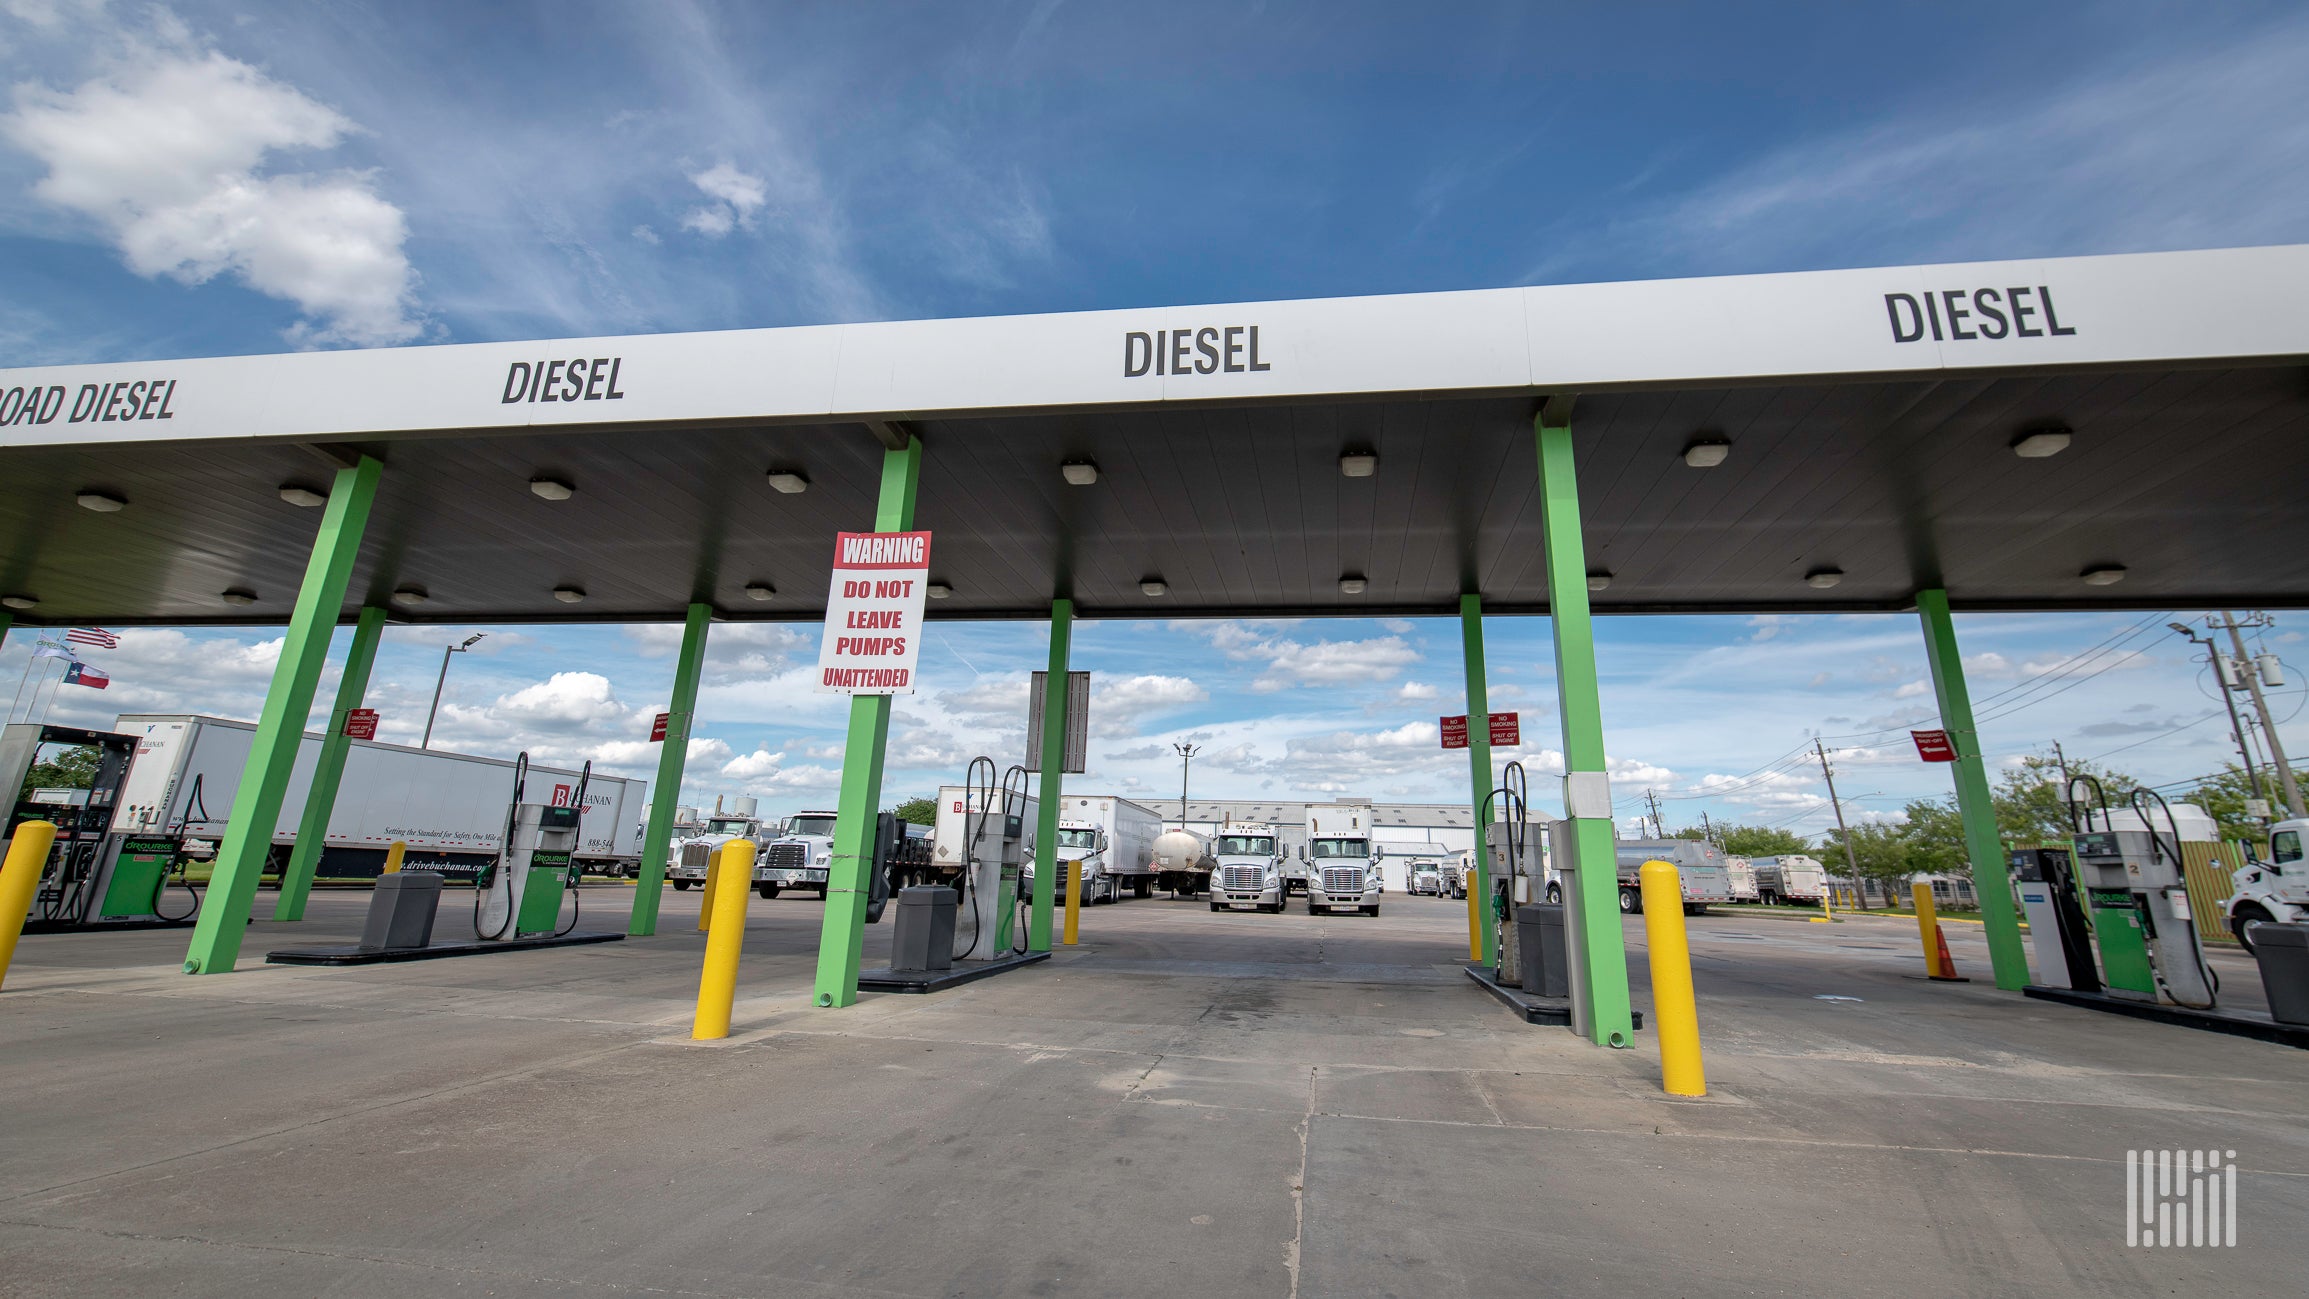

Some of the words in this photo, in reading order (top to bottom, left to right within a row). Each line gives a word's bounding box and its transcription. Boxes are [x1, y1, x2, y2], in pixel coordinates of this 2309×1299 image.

[1885, 286, 2077, 342] DIESEL
[1124, 325, 1270, 377] DIESEL
[502, 358, 624, 404] DIESEL
[0, 386, 66, 427] OAD
[68, 380, 177, 423] DIESEL
[843, 537, 924, 563] WARNING
[844, 581, 871, 598] DO
[875, 580, 914, 598] NOT
[847, 611, 902, 629] LEAVE
[836, 637, 906, 656] PUMPS
[823, 668, 909, 687] UNATTENDED
[384, 827, 406, 837] Setting
[417, 830, 443, 838] Standard
[443, 830, 453, 840] for
[472, 832, 484, 840] One
[485, 833, 497, 841] Mile
[1499, 853, 1505, 862] 3
[2129, 864, 2140, 874] 2
